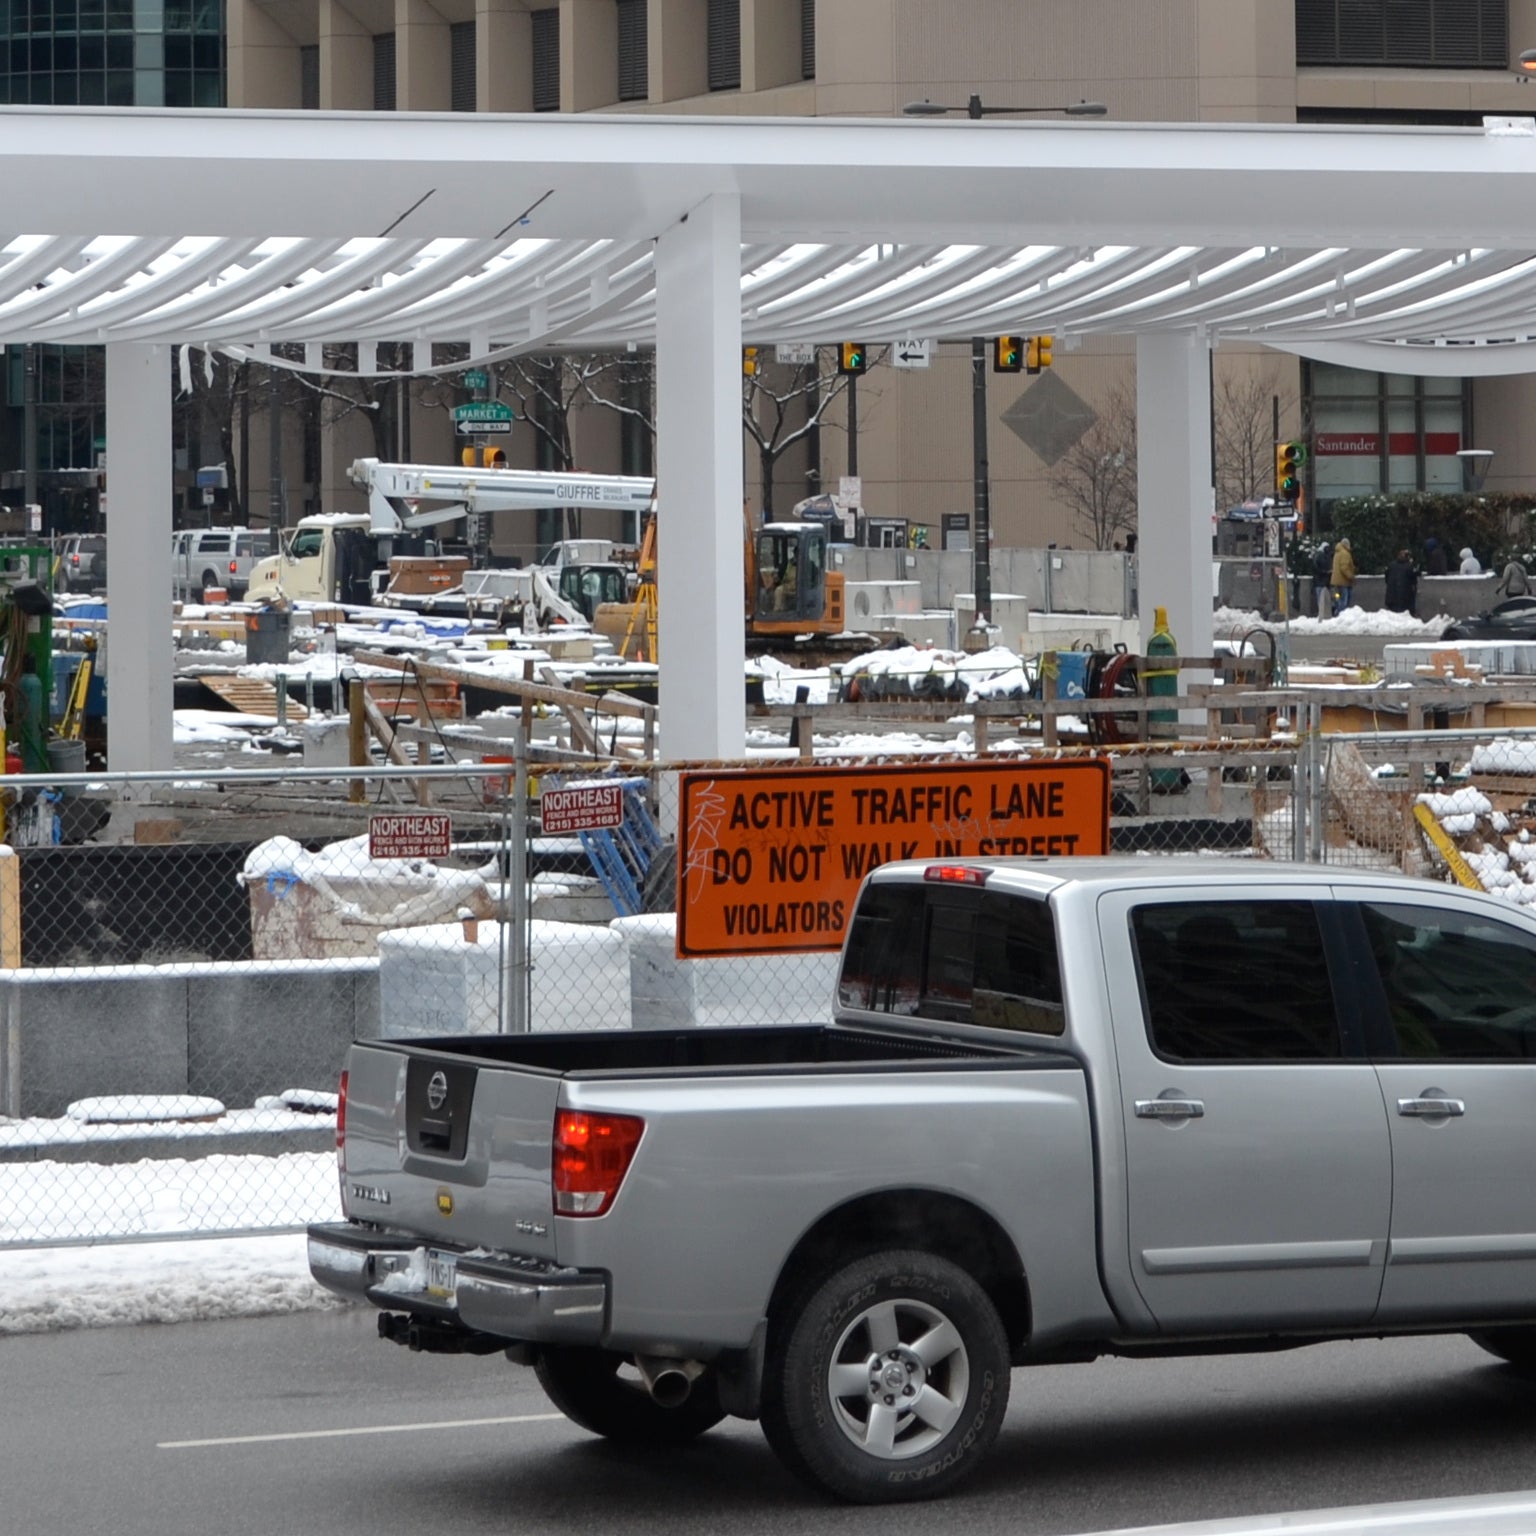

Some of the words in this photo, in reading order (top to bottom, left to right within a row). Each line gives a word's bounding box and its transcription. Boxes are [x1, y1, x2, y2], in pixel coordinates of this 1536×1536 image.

[779, 353, 792, 361] THE
[796, 353, 812, 361] BOX
[459, 409, 497, 418] MARKET
[1317, 438, 1376, 451] Santander
[556, 485, 601, 500] GIUFFRE
[545, 789, 618, 811] NORTHEAST
[729, 789, 835, 831] ACTIVE
[852, 784, 973, 825] TRAFFIC
[990, 781, 1065, 819] LANE
[372, 818, 448, 836] NORTHEAST
[545, 819, 571, 831] (215)
[372, 846, 399, 856] (215)
[712, 847, 753, 886] DO
[769, 845, 826, 883] NOT
[723, 900, 845, 936] VIOLATORS
[351, 1184, 391, 1205] TITAN
